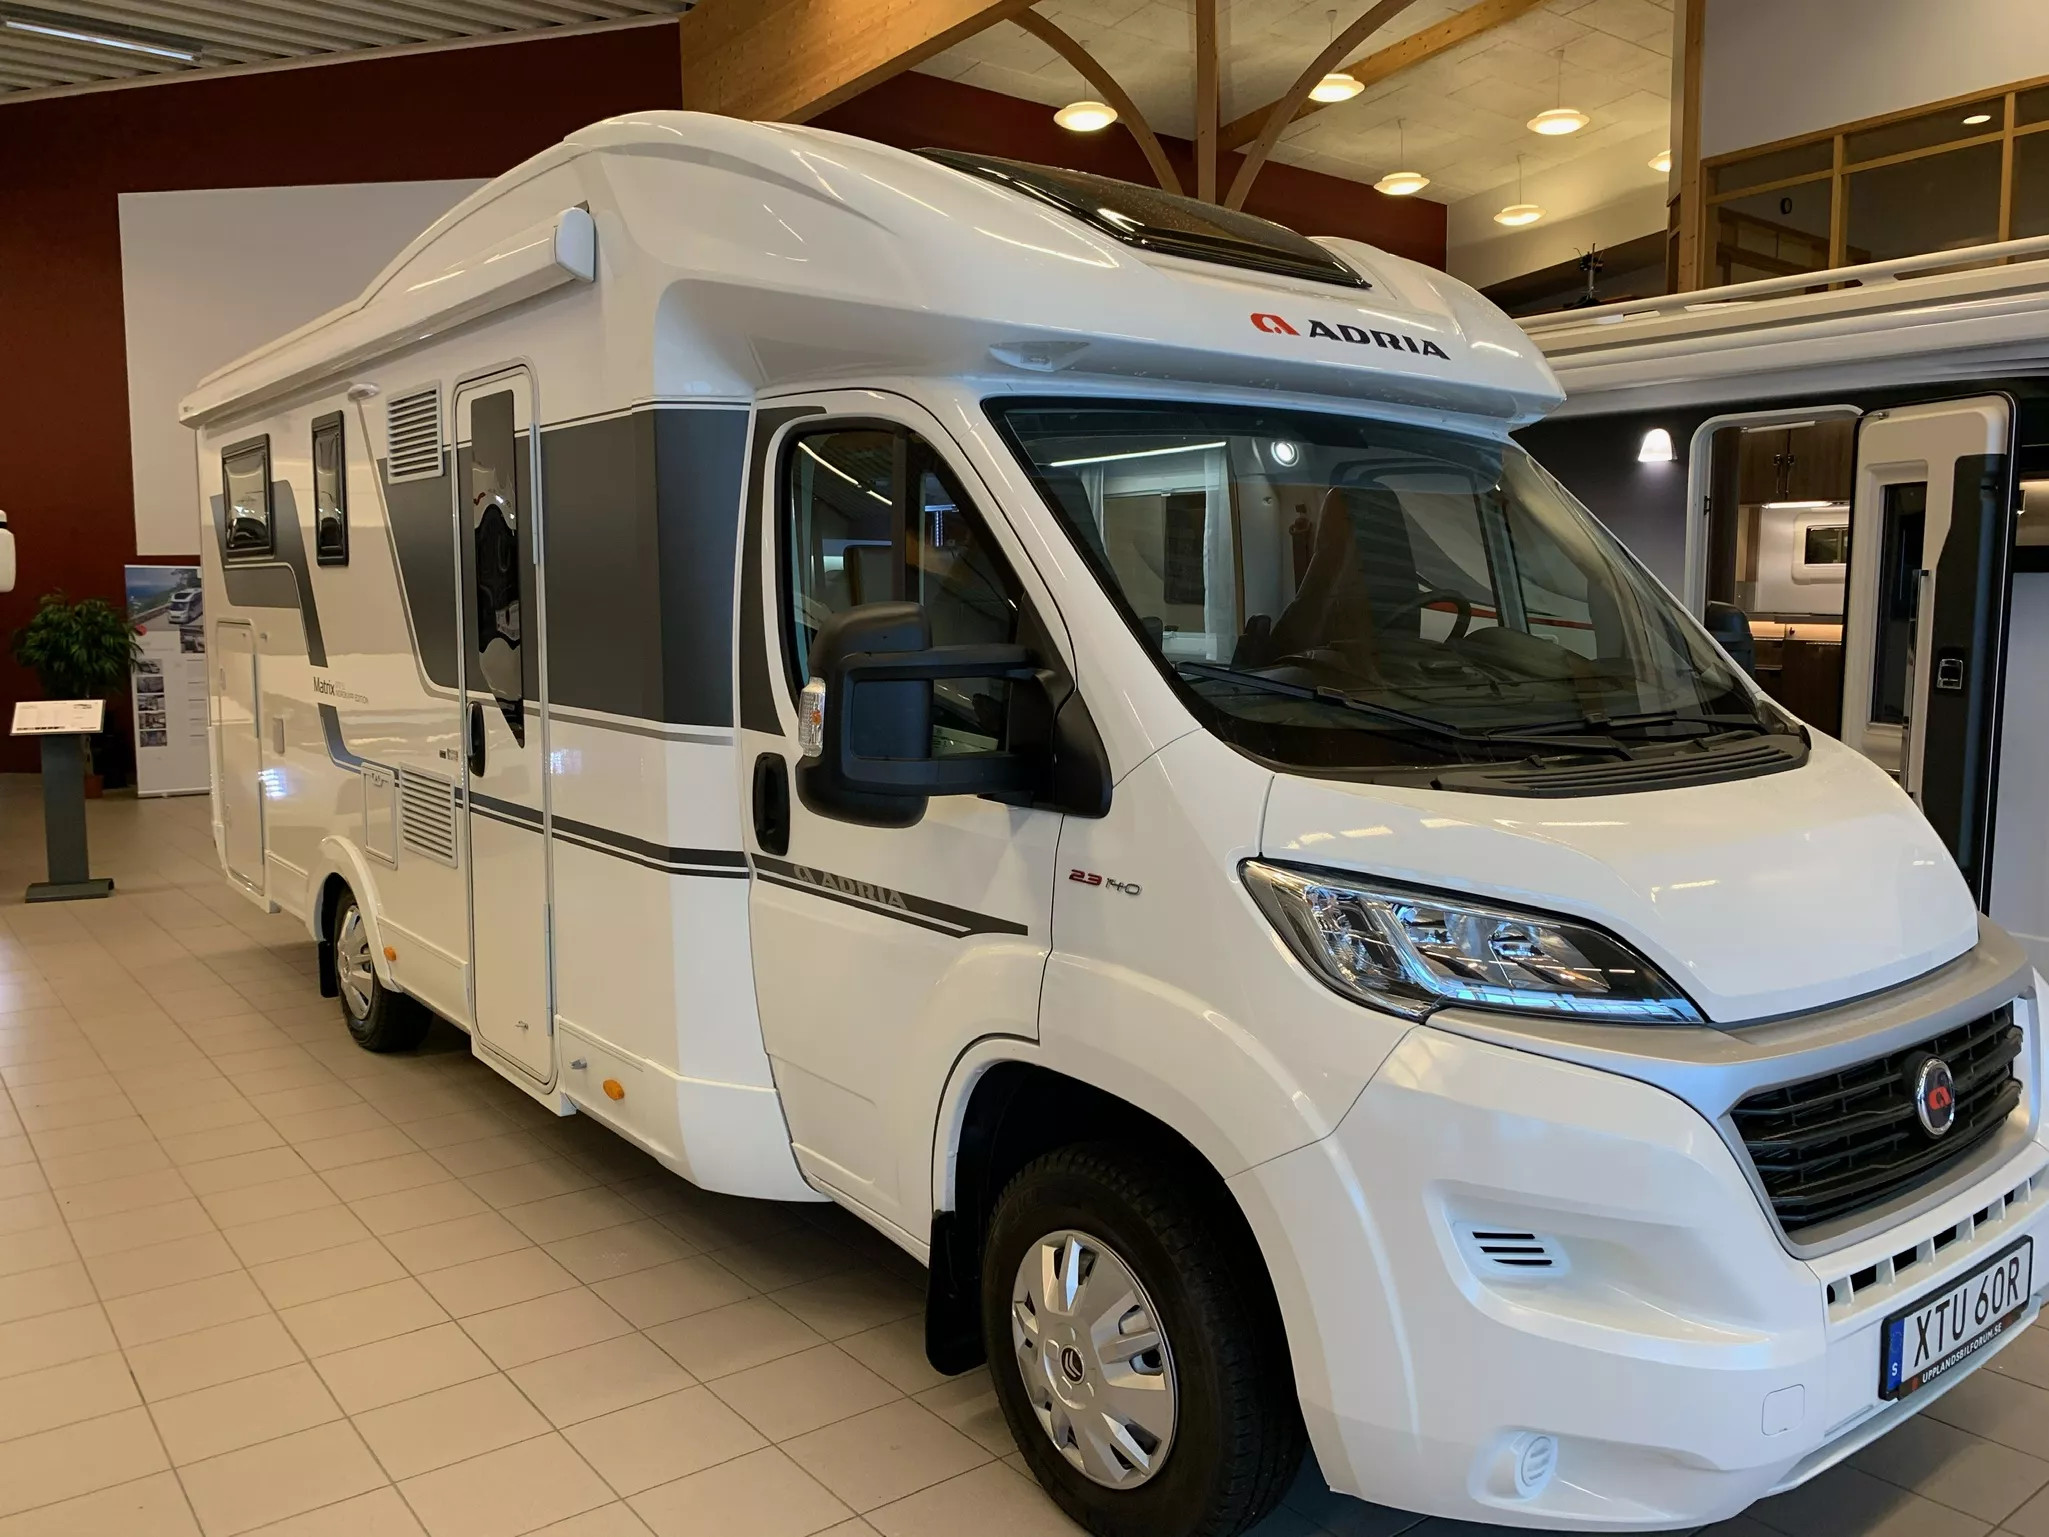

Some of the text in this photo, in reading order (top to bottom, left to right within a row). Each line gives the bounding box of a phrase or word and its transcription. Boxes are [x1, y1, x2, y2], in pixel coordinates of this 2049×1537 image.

[1308, 319, 1451, 361] ADRIA
[313, 676, 335, 696] Matrix
[821, 871, 908, 910] ADRIA
[1914, 1288, 1967, 1368] XTU
[1891, 1362, 1898, 1377] S
[1922, 1322, 2003, 1383] UPPLANDSBILFORUM.SE
